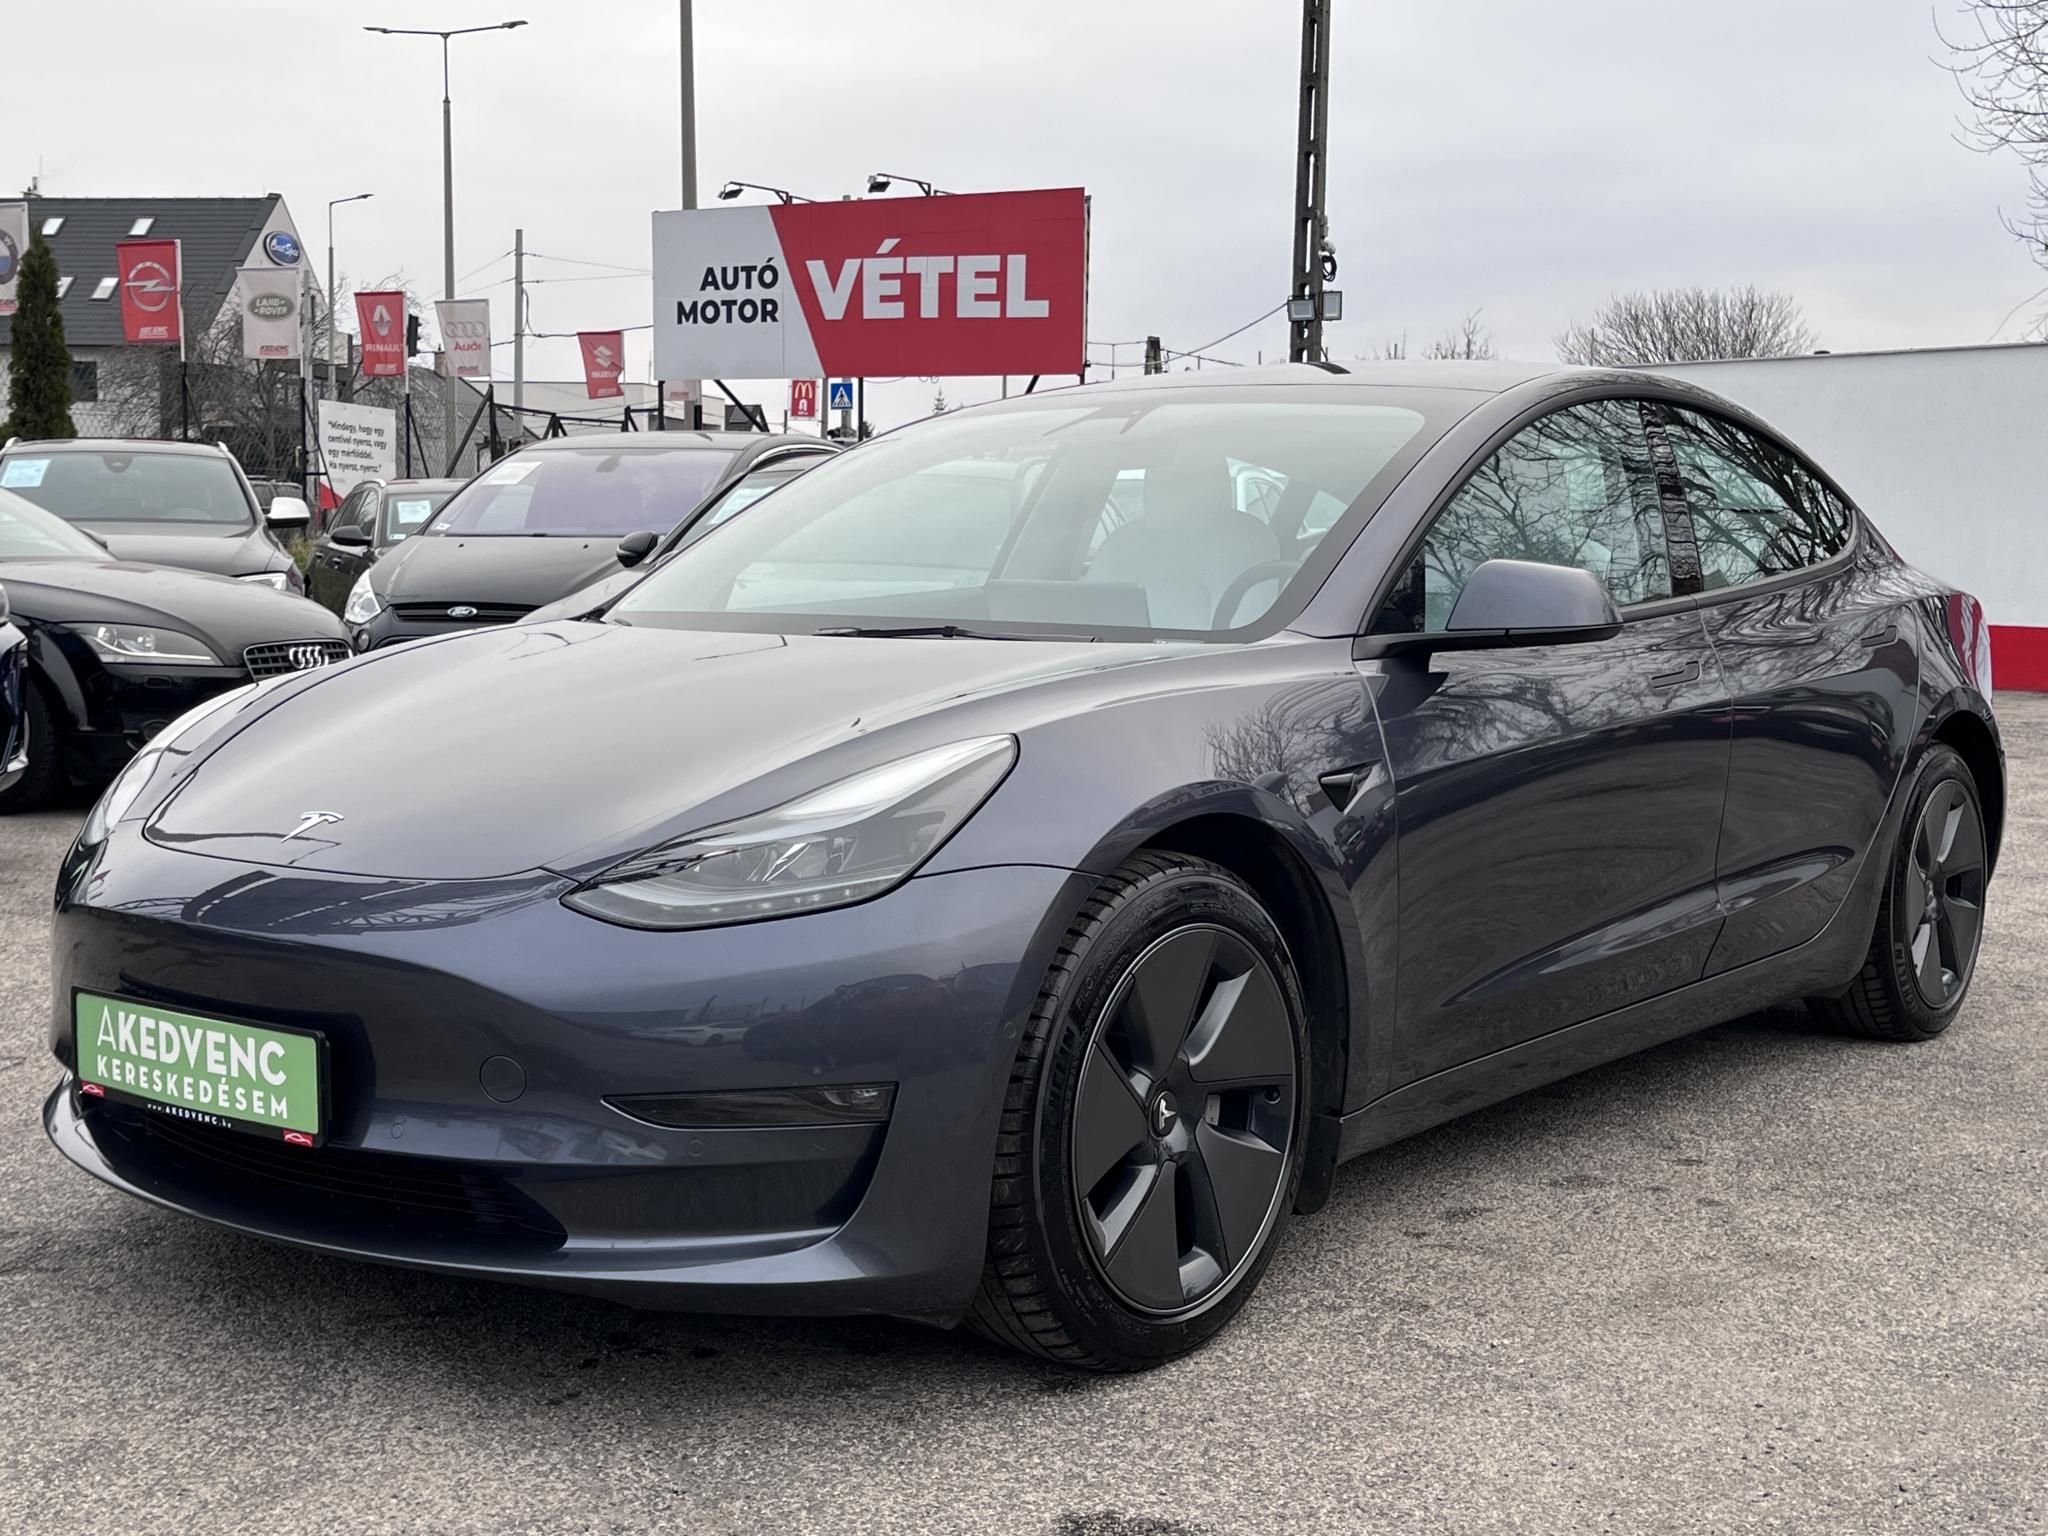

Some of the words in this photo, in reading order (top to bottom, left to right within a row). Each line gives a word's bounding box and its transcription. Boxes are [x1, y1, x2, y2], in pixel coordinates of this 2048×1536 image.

[700, 257, 779, 291] AUTÓ
[806, 238, 1049, 320] VÉTEL
[677, 298, 779, 325] MOTOR
[358, 423, 373, 436] hogy
[374, 428, 384, 437] egy
[373, 440, 387, 450] vagy
[328, 449, 339, 458] egy
[97, 1005, 287, 1086] AKEDVENC
[97, 1054, 288, 1119] KERESKEDÉSEM
